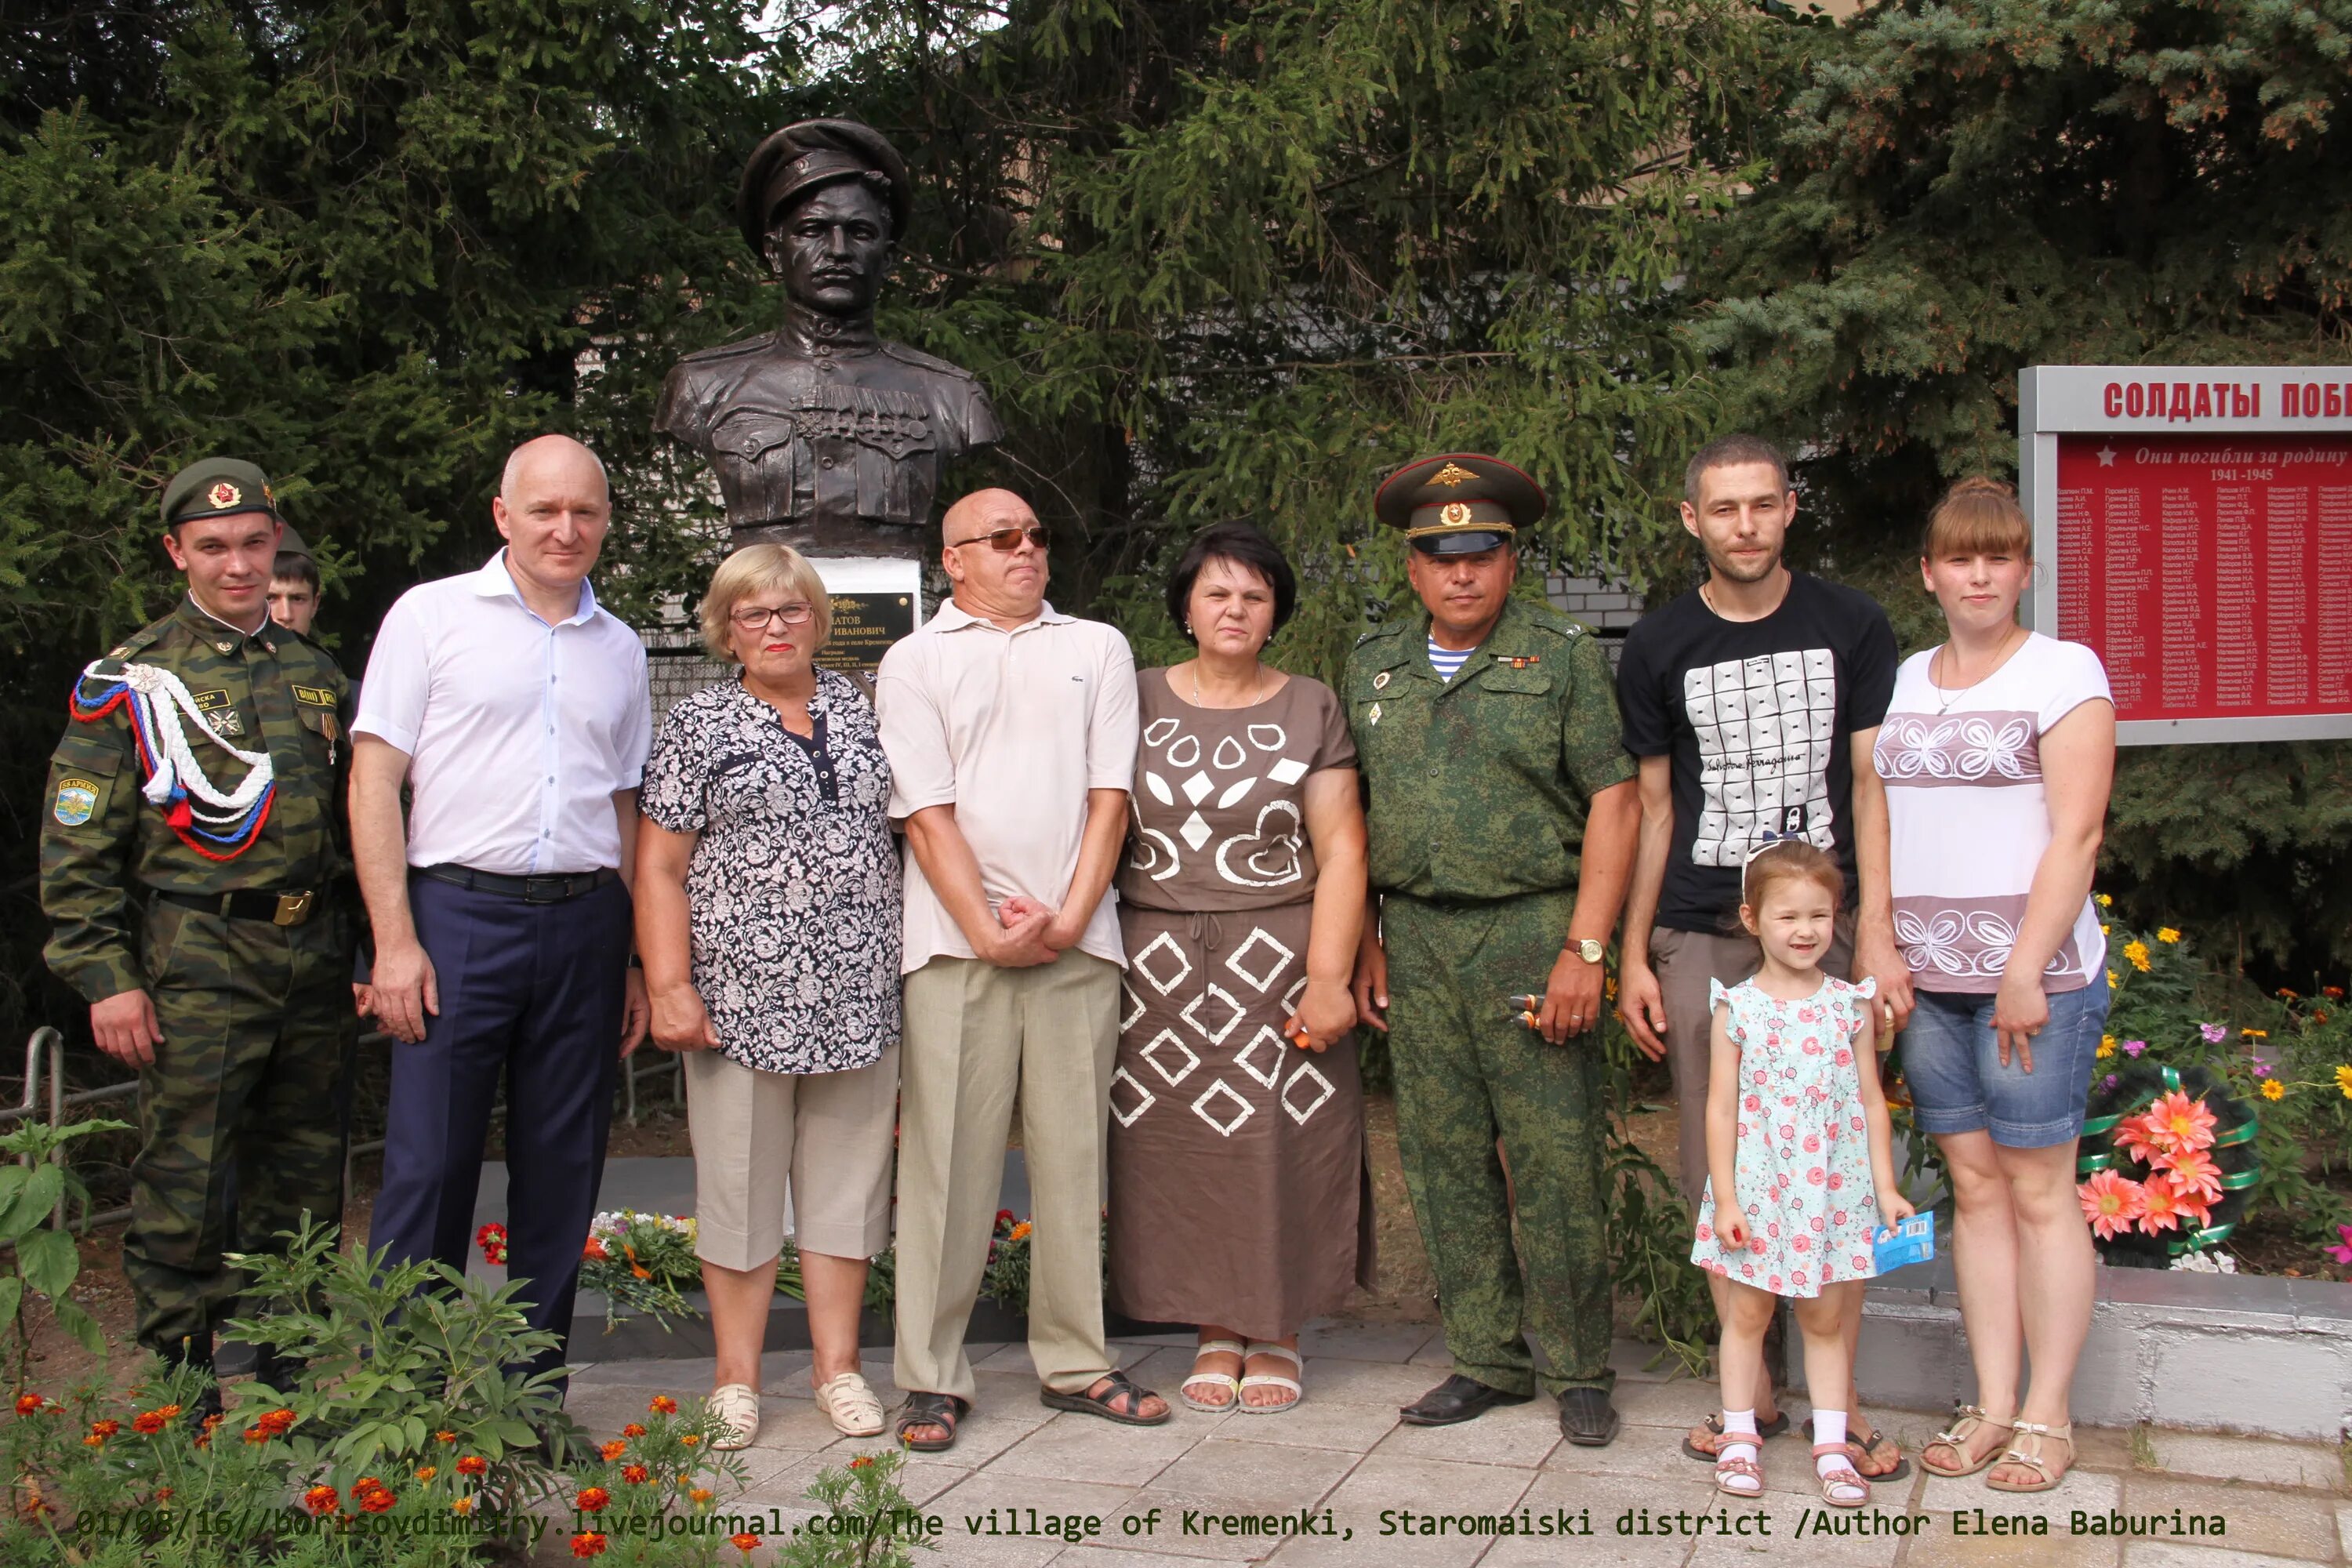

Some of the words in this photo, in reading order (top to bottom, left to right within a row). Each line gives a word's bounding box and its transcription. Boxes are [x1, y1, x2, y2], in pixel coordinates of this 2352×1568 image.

[2104, 383, 2260, 422] СОЛДАТЫ
[2135, 447, 2173, 465] Они
[2178, 449, 2254, 464] погибли
[2259, 452, 2277, 463] за
[2281, 448, 2347, 468] родину
[2211, 469, 2237, 481] 1941
[835, 627, 886, 635] ИВАНОВИЧ
[1745, 753, 1806, 775] Ferragamo
[71, 781, 96, 793] АРМИЯ
